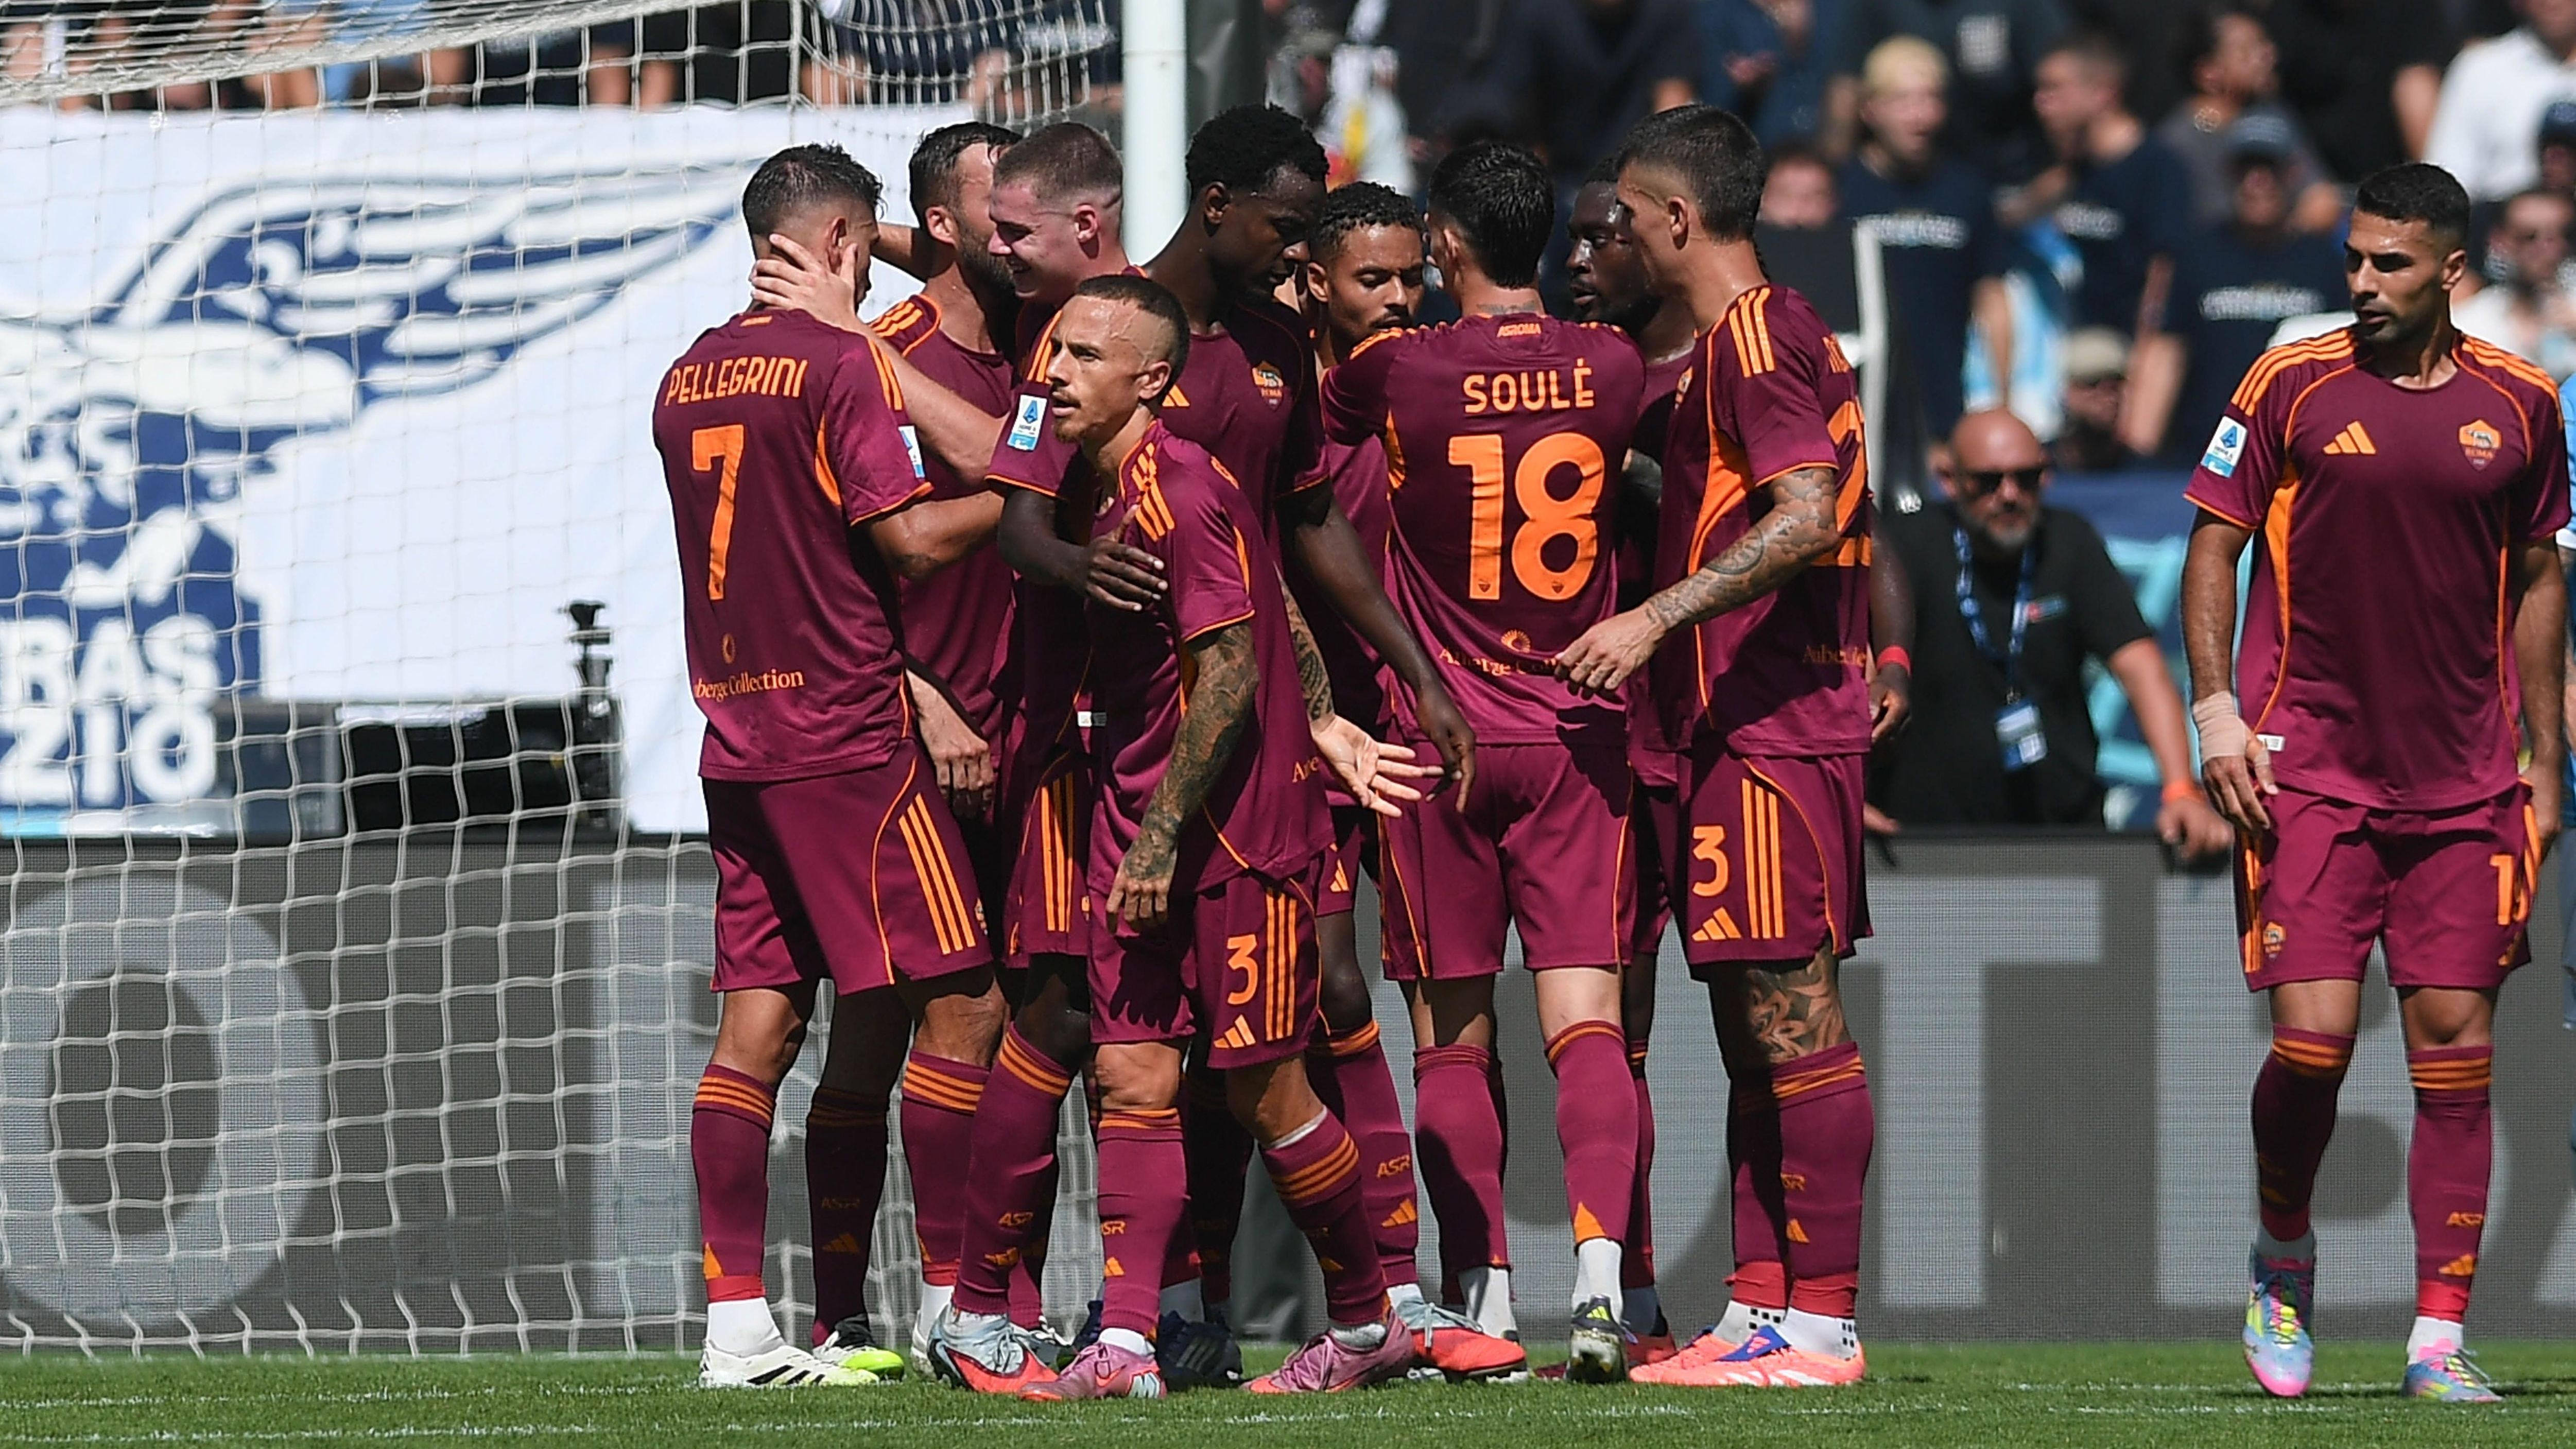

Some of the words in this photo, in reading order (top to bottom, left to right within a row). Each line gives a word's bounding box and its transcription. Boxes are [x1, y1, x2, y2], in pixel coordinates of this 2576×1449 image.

[665, 356, 808, 407] PELLEGRINI
[1463, 358, 1595, 413] SOULÉ
[691, 424, 745, 601] 7
[1448, 432, 1605, 601] 18
[729, 667, 804, 695] Collection
[1692, 825, 1730, 897] 3
[1227, 934, 1258, 1005] 3
[1377, 1154, 1410, 1178] ASR
[1100, 1220, 1126, 1235] SR
